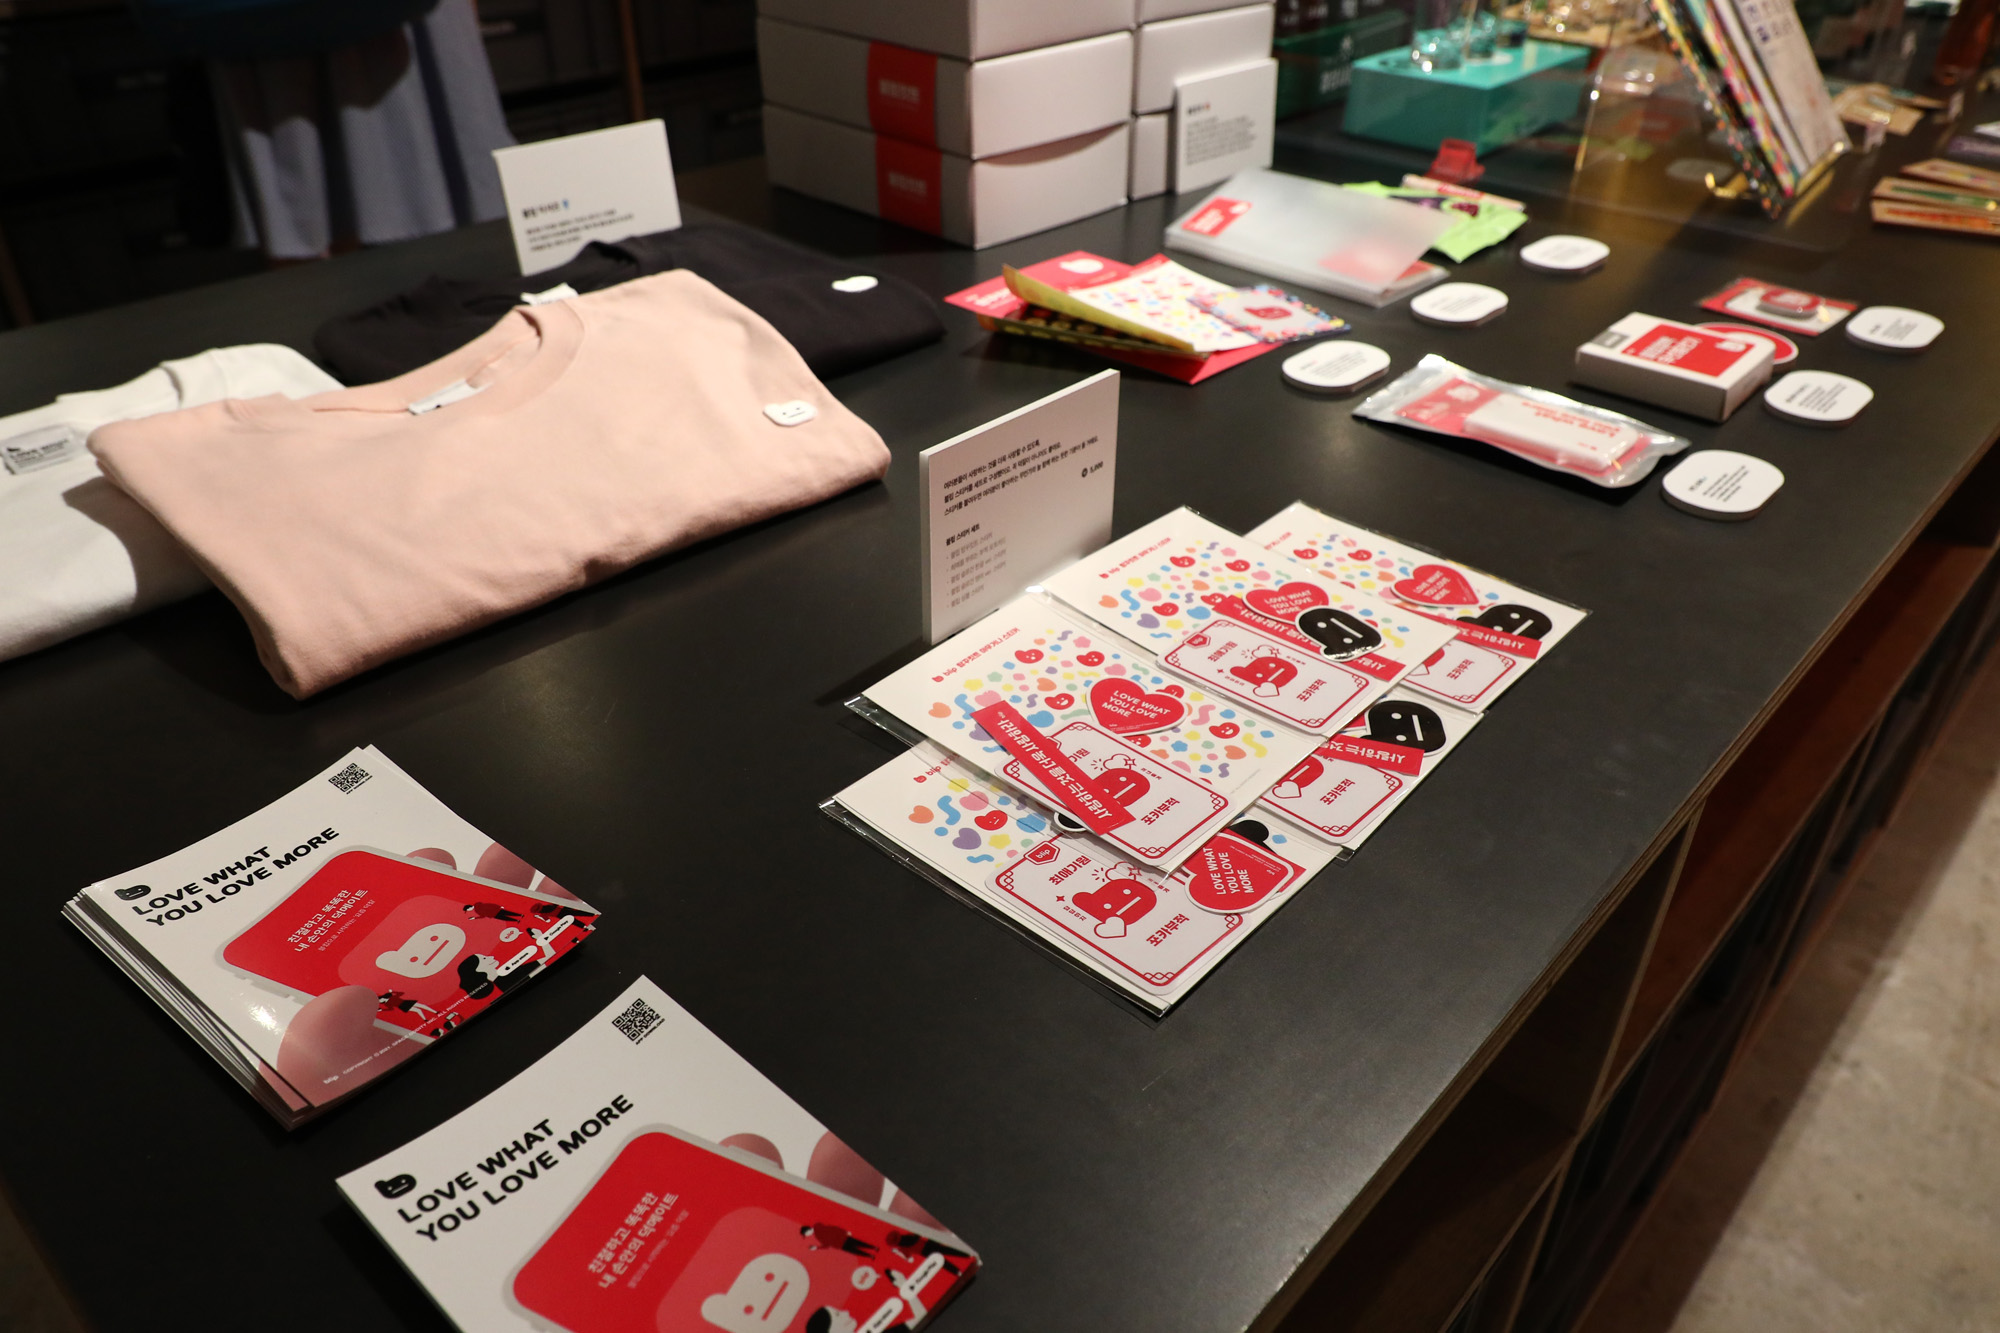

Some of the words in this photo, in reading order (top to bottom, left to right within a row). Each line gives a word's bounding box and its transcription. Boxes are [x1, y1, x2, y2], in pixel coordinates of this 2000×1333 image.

[968, 465, 986, 479] 사랑하는
[988, 460, 997, 470] 것을
[997, 456, 1007, 467] 더욱
[1007, 448, 1021, 462] 사랑할
[944, 493, 954, 503] 블립
[954, 483, 973, 497] 스티커를
[973, 477, 988, 489] 세트로
[944, 501, 963, 516] 스티커를
[1001, 475, 1019, 489] 좋아하는
[945, 534, 956, 546] 블립
[956, 528, 970, 540] 스티커
[971, 523, 980, 533] 세트
[1264, 595, 1287, 605] LOVE
[1286, 589, 1313, 600] WHAT
[1270, 602, 1291, 611] YOU
[1290, 597, 1314, 606] LOVE
[1275, 606, 1300, 615] MORE
[943, 667, 958, 677] blip
[1002, 627, 1020, 641] 스티커
[1207, 641, 1238, 663] 최애기원
[1470, 629, 1525, 650] 사랑하는
[1446, 658, 1475, 680] 포카부적
[1113, 690, 1141, 705] LOVE
[1141, 701, 1171, 715] WHAT
[1296, 678, 1328, 703] 포카부적
[1101, 702, 1132, 718] MORE
[1109, 696, 1130, 709] YOU
[1130, 705, 1158, 719] LOVE
[997, 719, 1039, 752] 사랑하라
[1030, 749, 1057, 769] 더욱
[1345, 744, 1406, 765] 사랑하는
[925, 765, 942, 776] blip
[1048, 765, 1075, 787] 것을
[1067, 782, 1113, 819] 사랑하는
[1319, 778, 1356, 806] 포카부적
[1140, 797, 1181, 826] 포카부적
[1035, 848, 1051, 860] blip
[1202, 847, 1218, 874] WHAT
[1218, 851, 1234, 875] LOVE
[131, 879, 204, 918] LOVE
[204, 846, 273, 884] WHAT
[146, 896, 203, 928] YOU
[204, 866, 272, 905] LOVE
[273, 827, 341, 870] MORE
[1048, 855, 1093, 886] 최애기원
[1210, 869, 1227, 896] LOVE
[1225, 871, 1241, 895] YOU
[1238, 868, 1254, 894] MORE
[287, 913, 326, 943] 친절하고
[321, 889, 352, 913] 똑똑한
[294, 942, 310, 952] 내
[307, 919, 336, 943] 손안의
[331, 889, 369, 919] 덕메이트
[318, 934, 339, 952] 블립으로
[336, 918, 357, 935] 시작하는
[1146, 913, 1191, 947] 포카부적
[322, 1074, 339, 1085] blip
[342, 1055, 374, 1075] COPYRIGHT
[391, 1035, 409, 1047] SPACE
[437, 1010, 447, 1018] ALL
[446, 998, 465, 1012] RIGHTS
[463, 982, 489, 1000] RESERVED
[397, 1169, 479, 1225] LOVE
[476, 1118, 557, 1176] WHAT
[416, 1199, 482, 1244] YOU
[488, 1150, 559, 1207] LOVE
[558, 1094, 634, 1155] MORE
[587, 1227, 631, 1274] 친절하고
[624, 1192, 659, 1227] 똑똑한
[597, 1272, 617, 1289] 내
[612, 1237, 645, 1276] 손안의
[637, 1192, 680, 1238] 덕메이트
